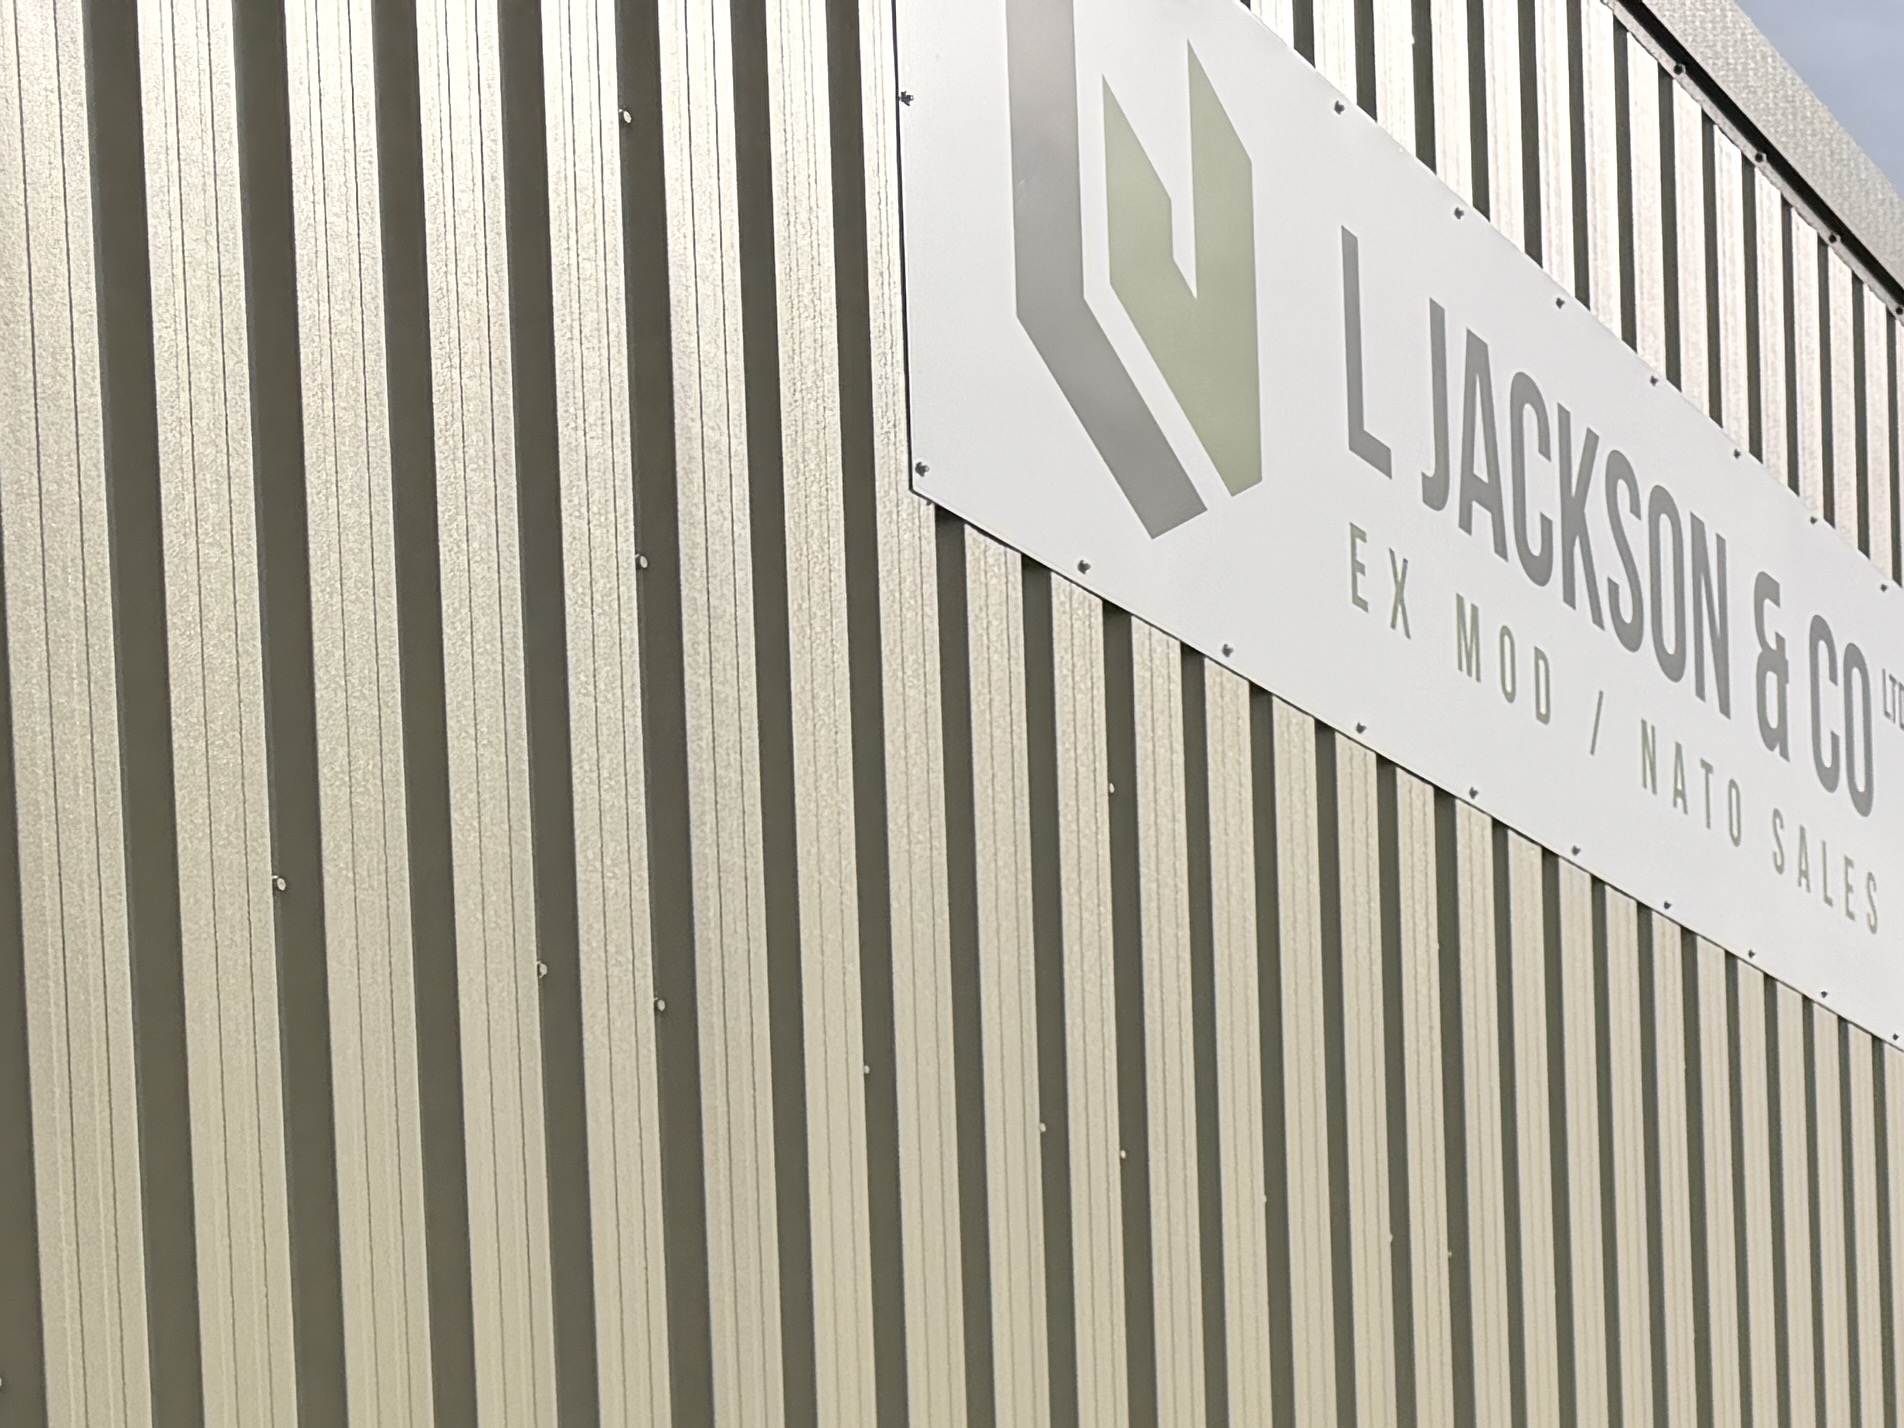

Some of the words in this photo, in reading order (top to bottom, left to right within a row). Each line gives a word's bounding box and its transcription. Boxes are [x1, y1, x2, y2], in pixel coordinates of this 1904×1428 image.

[1340, 224, 1393, 481] L
[1420, 296, 1732, 721] JACKSON
[1753, 570, 1791, 763] &
[1808, 613, 1875, 818] CO
[1348, 521, 1412, 641] EX
[1455, 592, 1552, 726] MOD
[1640, 717, 1742, 848] NATO
[1771, 807, 1879, 936] SALES
